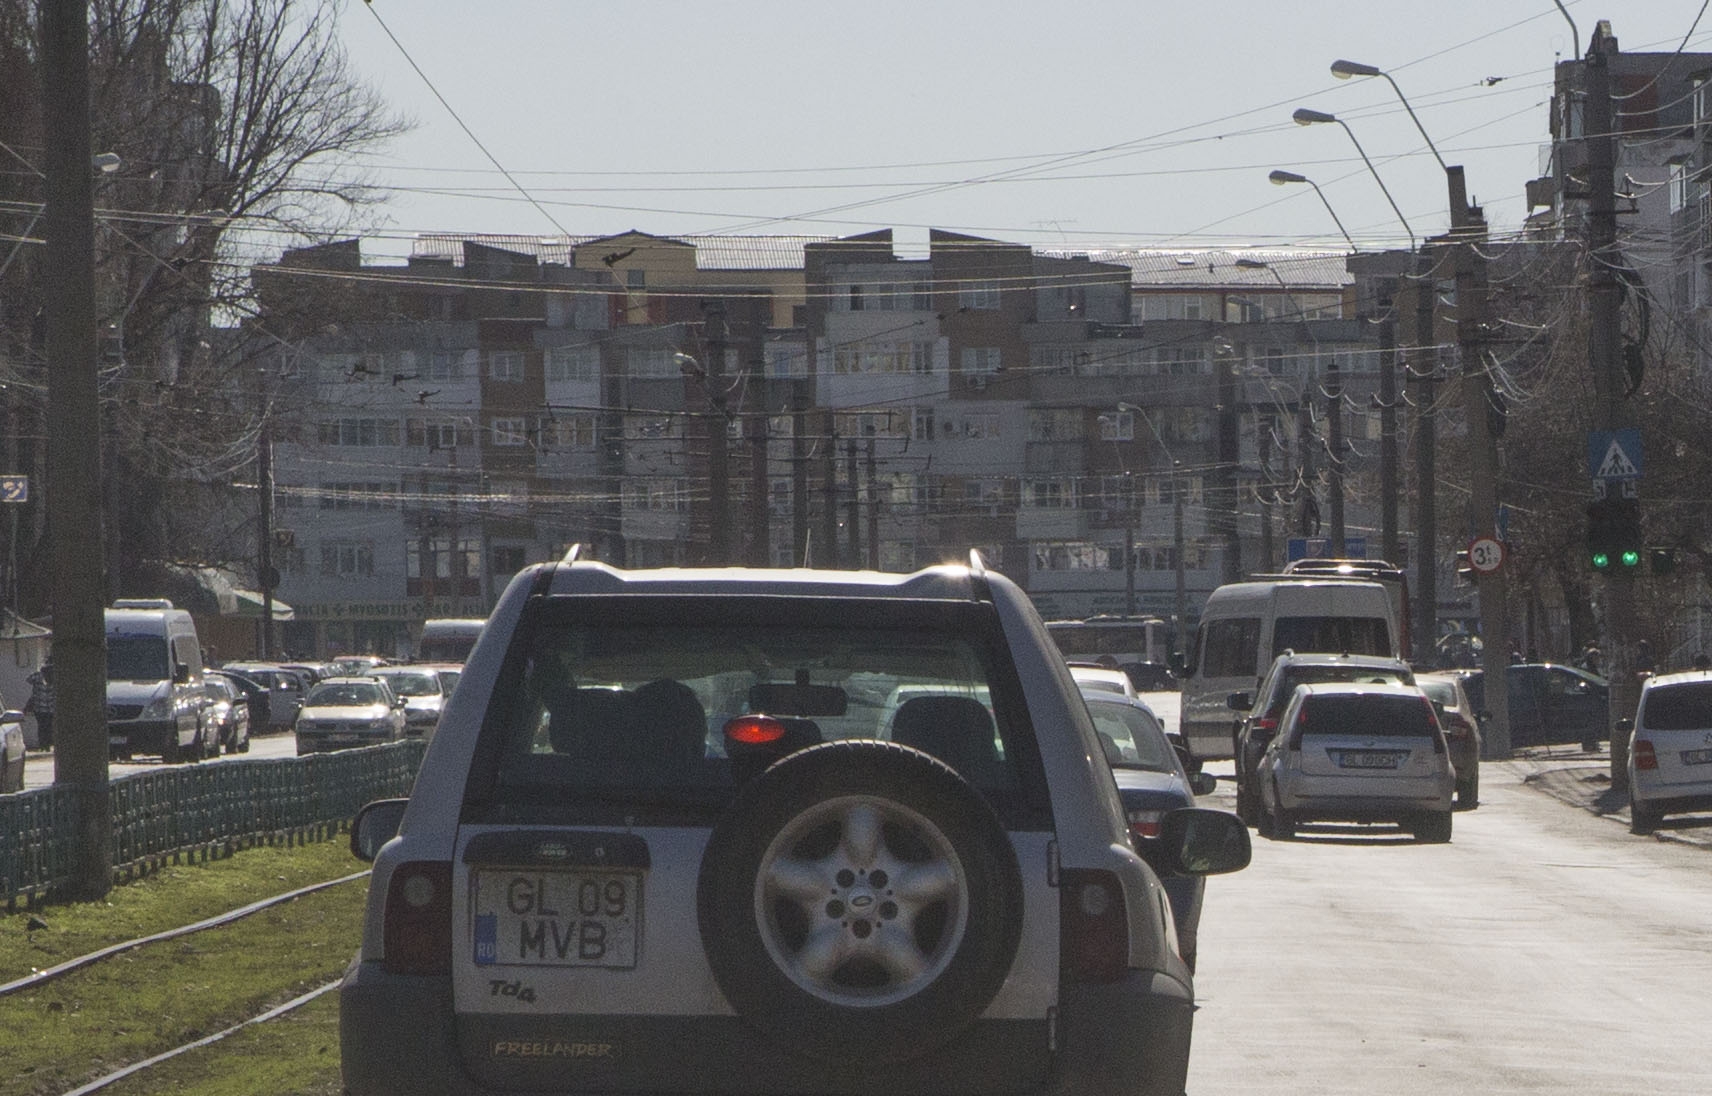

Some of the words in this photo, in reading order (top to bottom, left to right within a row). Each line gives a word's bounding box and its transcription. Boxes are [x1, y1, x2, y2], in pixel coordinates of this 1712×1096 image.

[507, 877, 559, 916] GL
[577, 879, 626, 917] 09
[520, 920, 607, 960] MVB
[494, 1039, 613, 1058] FREELANDER
